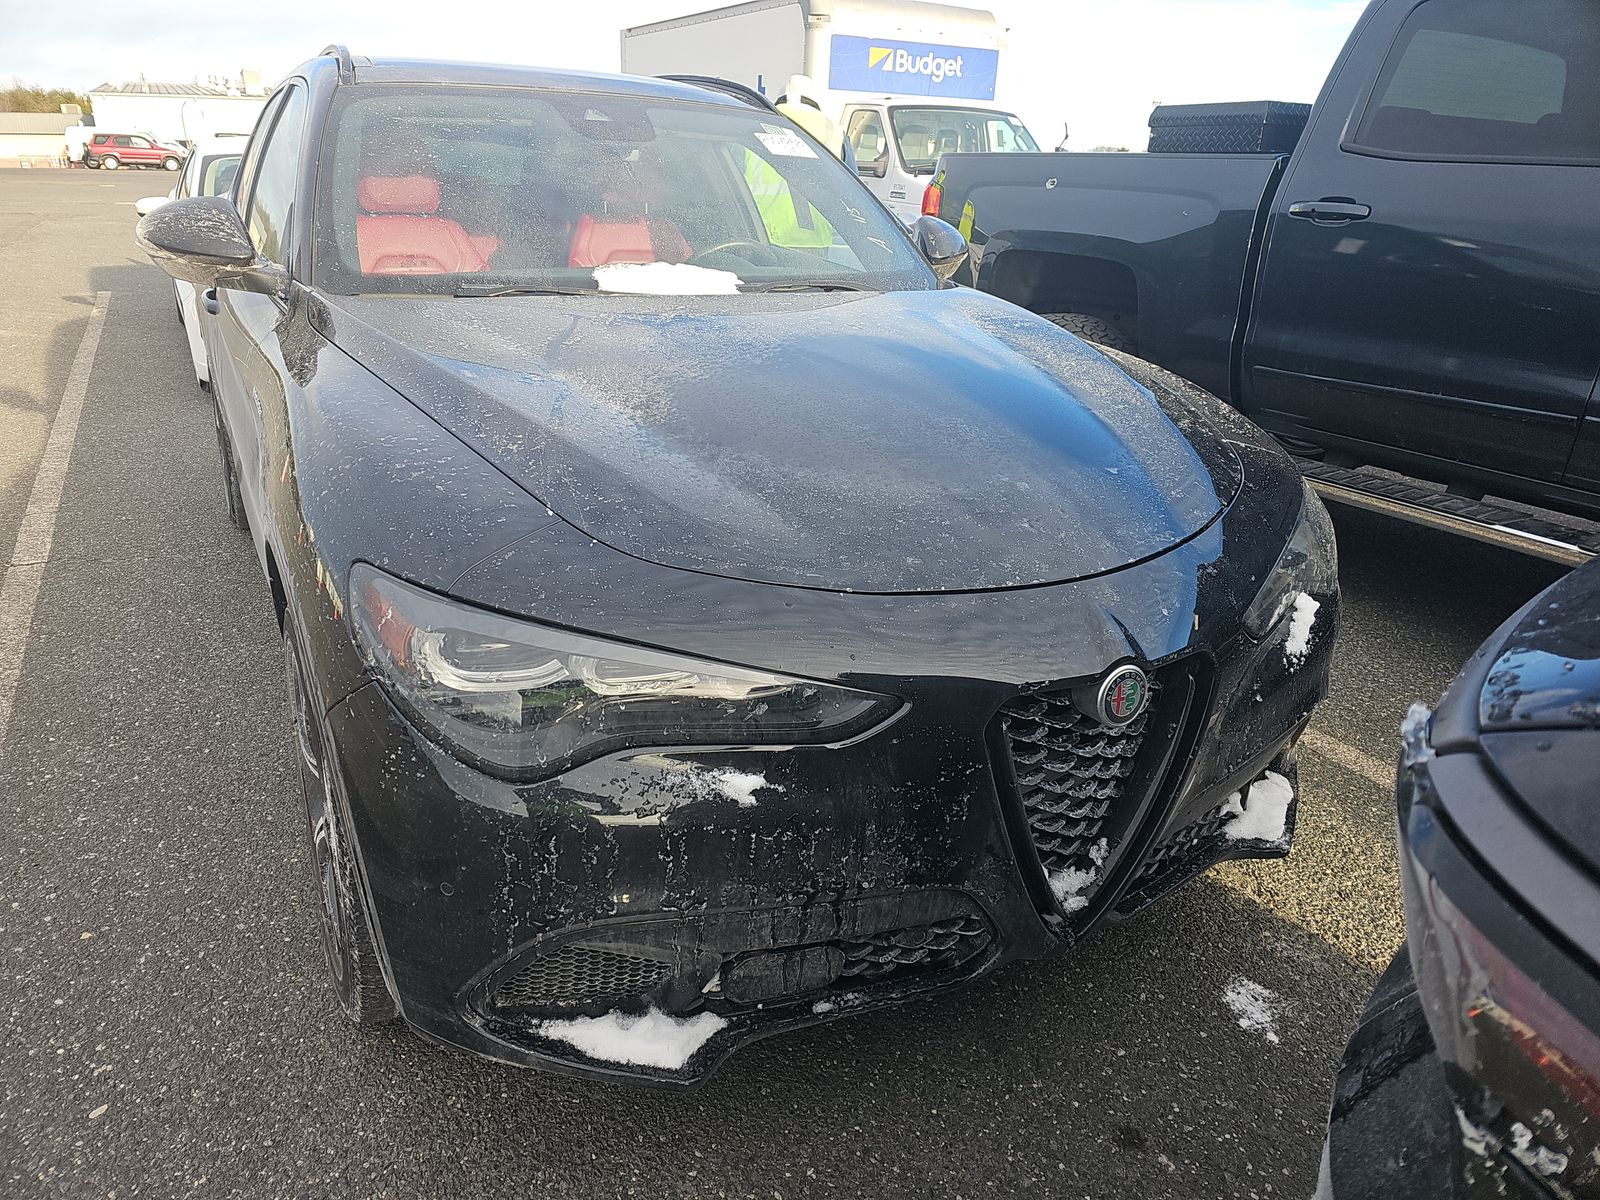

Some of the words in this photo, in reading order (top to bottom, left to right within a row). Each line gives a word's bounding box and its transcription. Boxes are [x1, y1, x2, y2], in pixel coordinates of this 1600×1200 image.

[895, 49, 963, 84] Budget
[1106, 677, 1122, 702] ALFA
[1124, 672, 1145, 695] ROMEO
